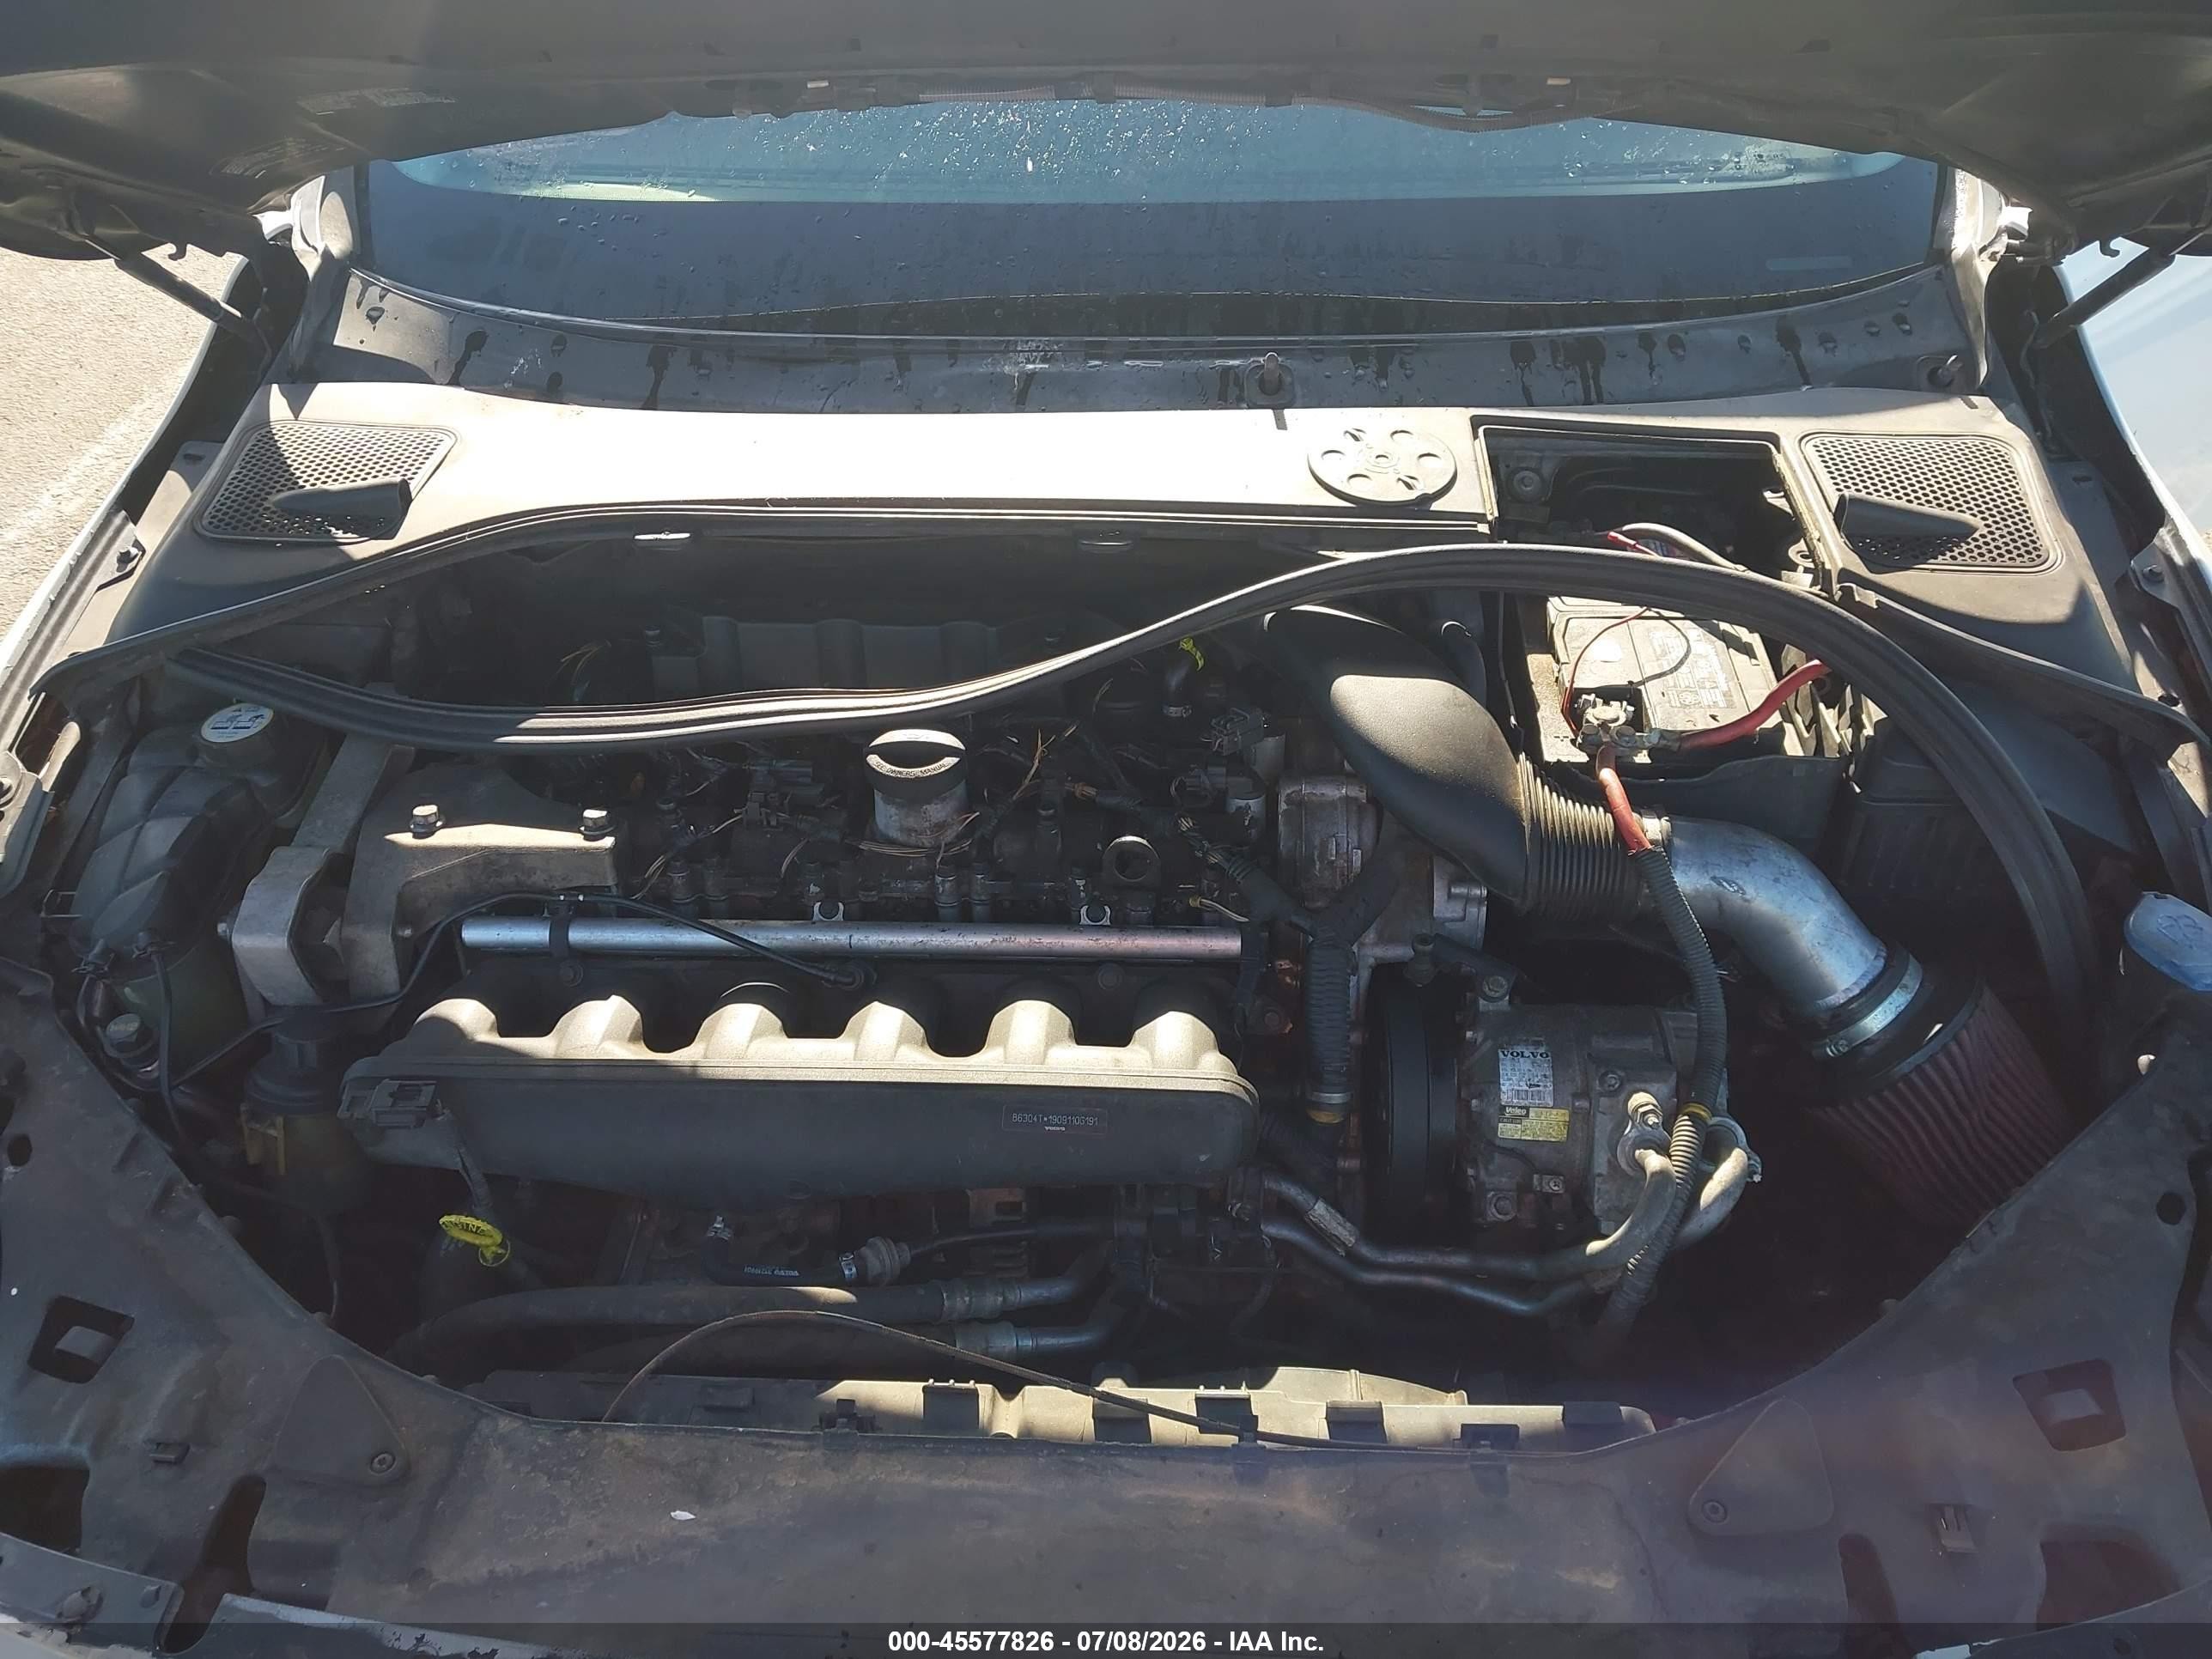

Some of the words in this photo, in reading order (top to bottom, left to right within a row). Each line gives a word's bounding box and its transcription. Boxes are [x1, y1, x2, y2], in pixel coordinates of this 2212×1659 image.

[875, 761, 886, 772] SEE
[920, 763, 949, 775] MANUAL
[1501, 1050, 1549, 1059] VOLVO
[1505, 1106, 1527, 1115] Valeo
